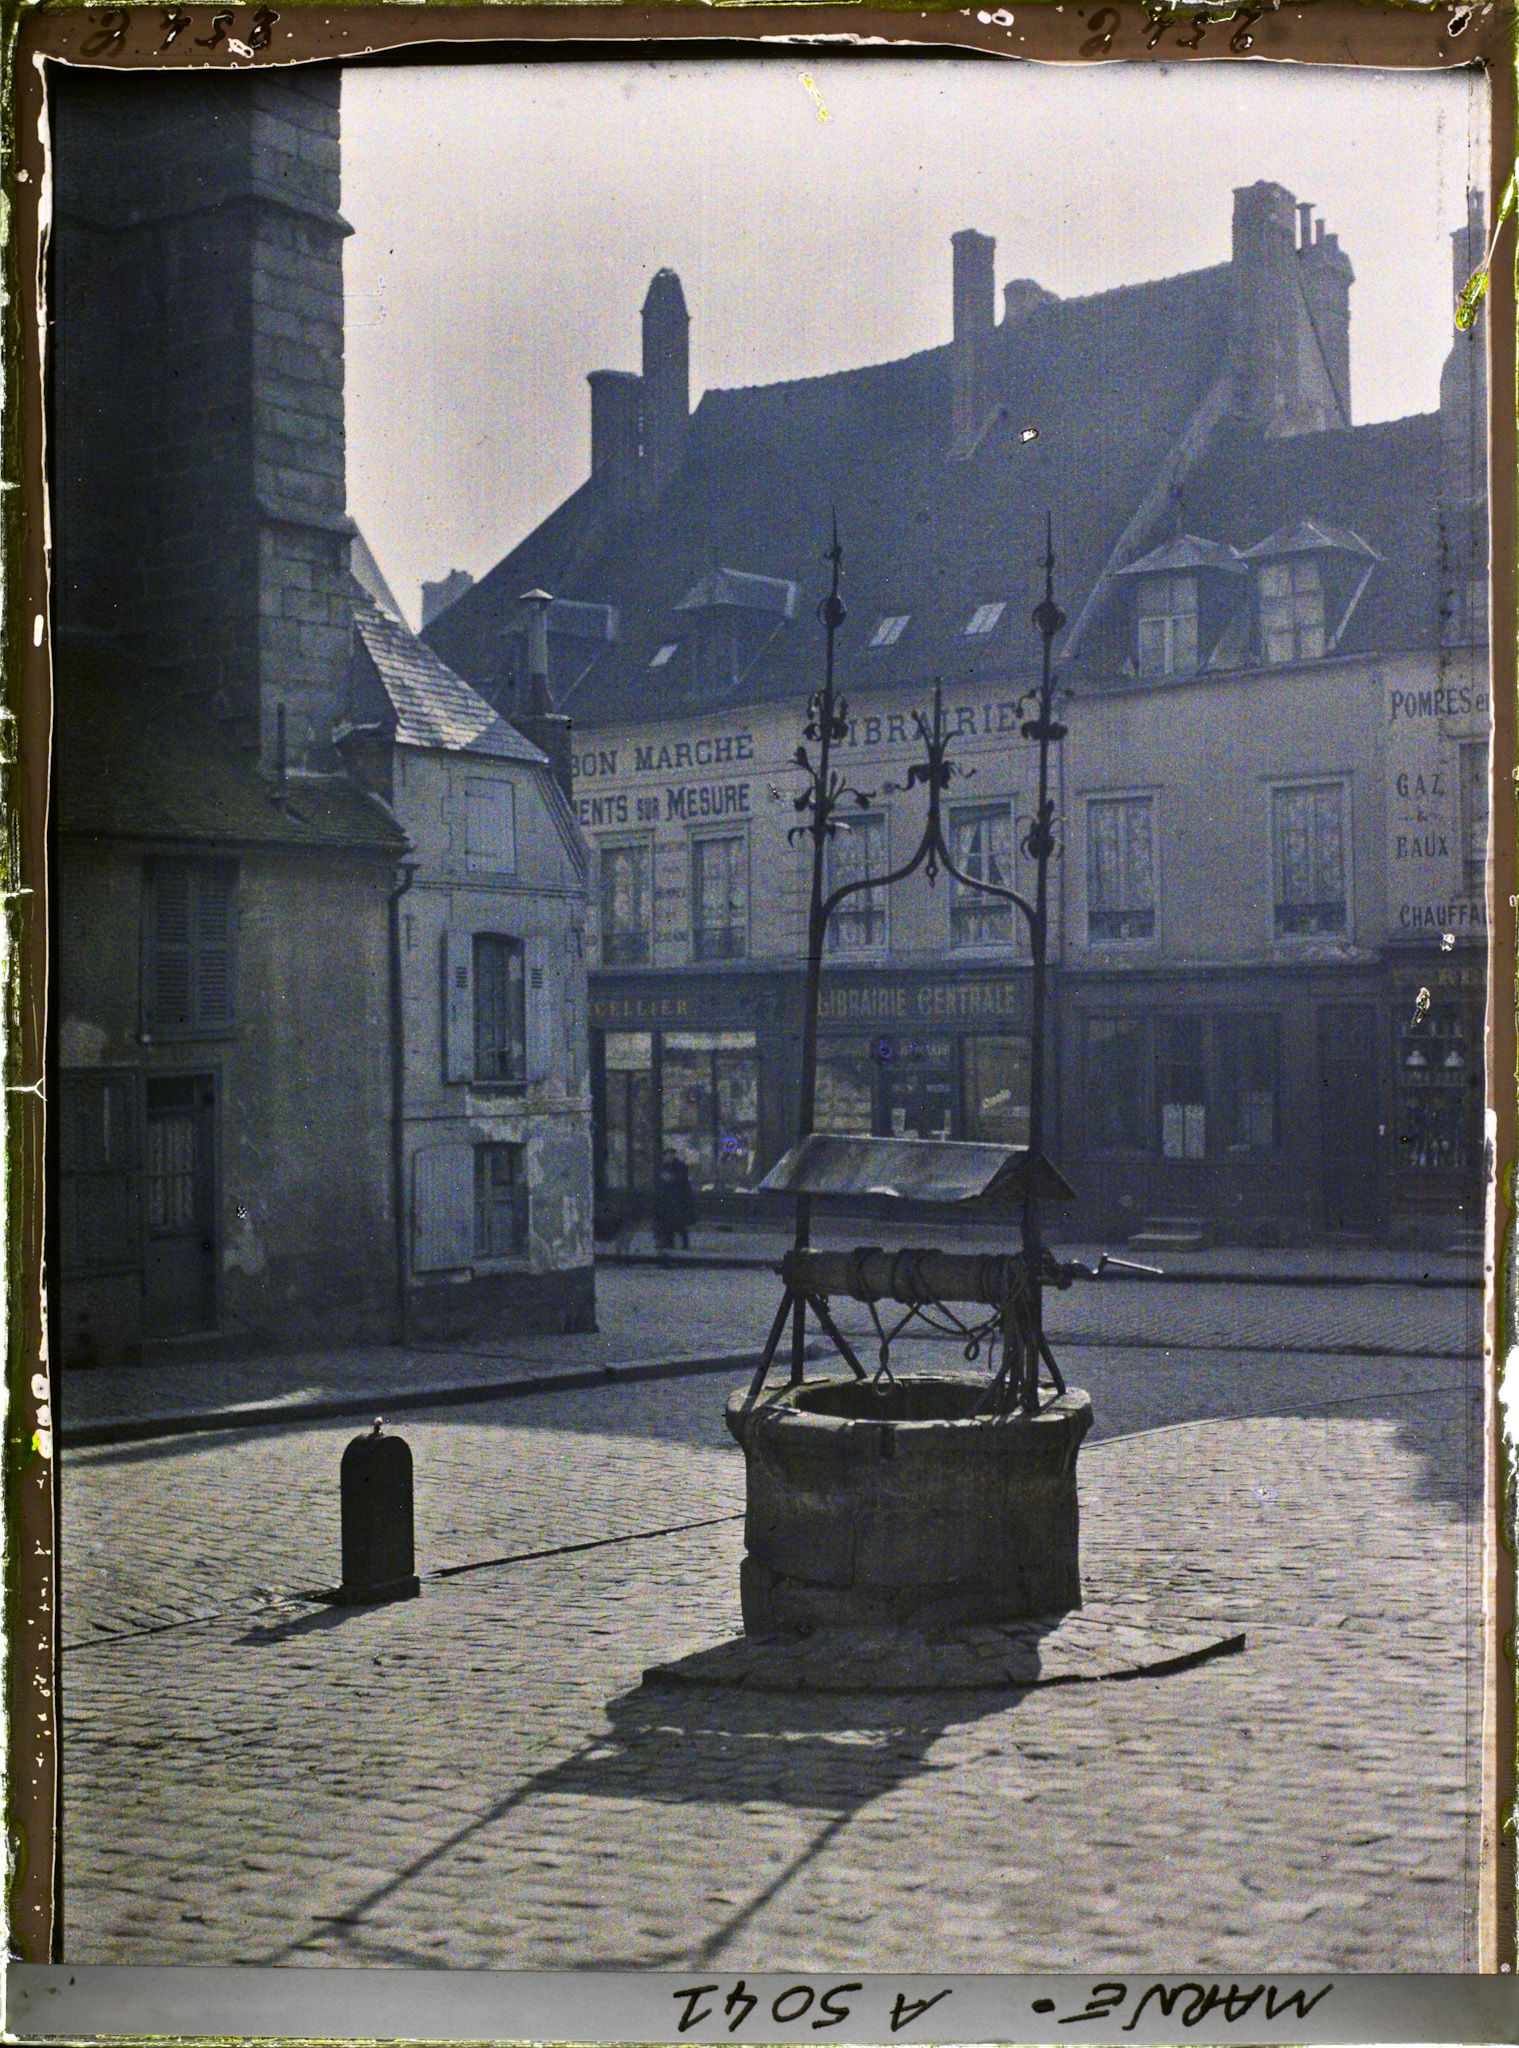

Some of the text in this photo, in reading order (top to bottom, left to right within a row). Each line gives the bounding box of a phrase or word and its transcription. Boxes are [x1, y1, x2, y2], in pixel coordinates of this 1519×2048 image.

[1390, 687, 1471, 722] POMPES
[828, 702, 1015, 748] IBRAIRIE
[634, 735, 754, 771] MARCHE
[665, 783, 751, 821] MESURE
[1396, 772, 1445, 798] GAZ
[917, 983, 1016, 1016] CENTRALE
[673, 1980, 863, 2032] 5041
[889, 1988, 953, 2032] A
